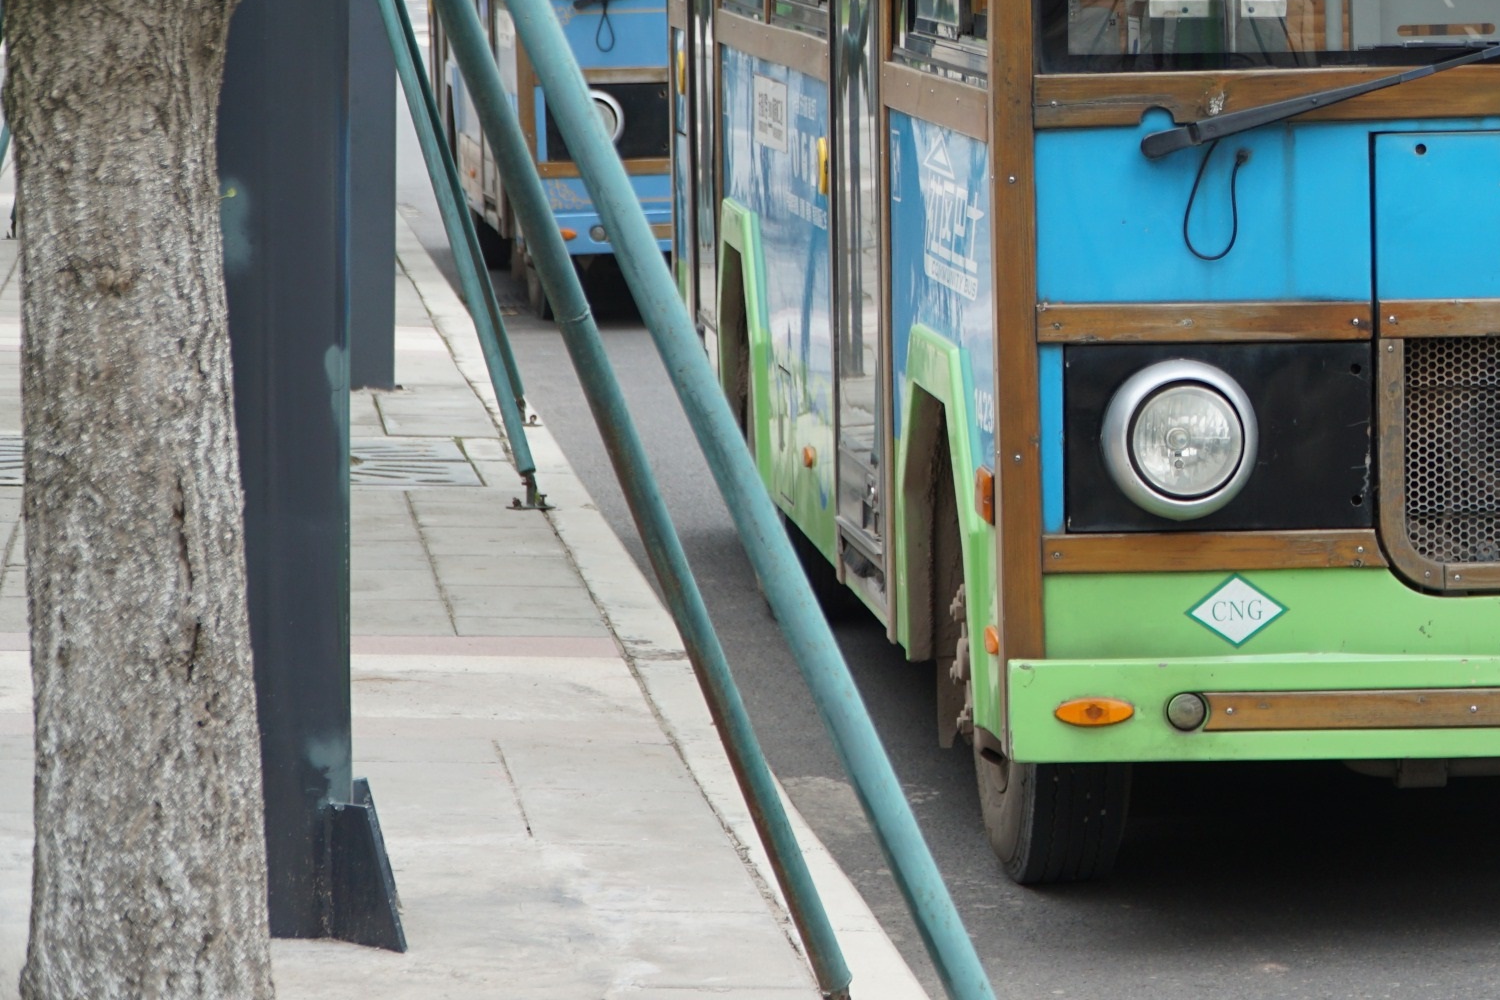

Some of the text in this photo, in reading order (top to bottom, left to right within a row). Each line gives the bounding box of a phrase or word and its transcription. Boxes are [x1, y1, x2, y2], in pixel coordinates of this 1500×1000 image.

[926, 174, 985, 274] 社区巴士
[931, 260, 976, 298] COMMUNITY BUS
[1212, 600, 1263, 621] CNG
